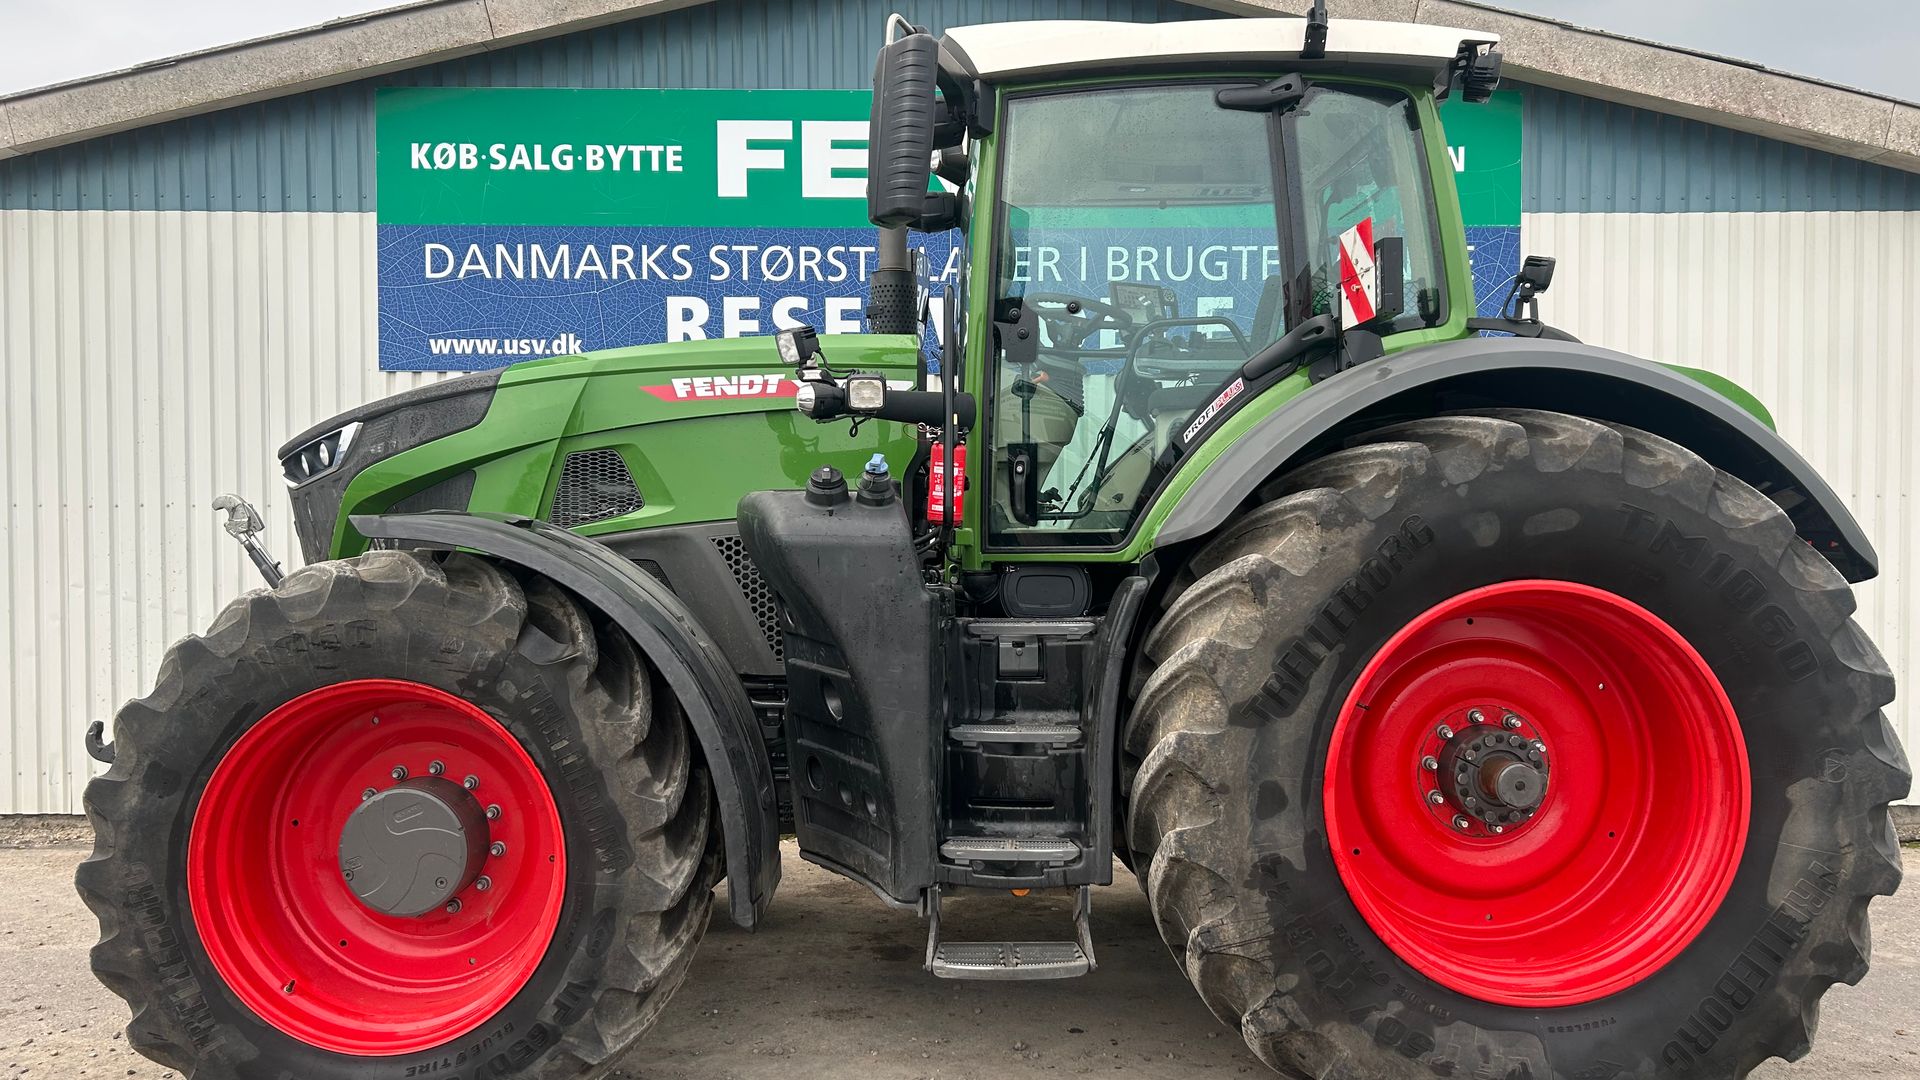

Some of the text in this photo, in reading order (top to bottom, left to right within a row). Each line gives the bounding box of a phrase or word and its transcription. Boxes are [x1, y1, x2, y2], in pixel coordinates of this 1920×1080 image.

[716, 119, 870, 198] FE
[424, 242, 694, 281] DANMARKS
[709, 244, 877, 283] STØRST
[666, 296, 862, 343] RESE
[429, 333, 583, 355] www.usv.dk
[671, 373, 786, 398] FENDT
[1239, 513, 1435, 723] TRELLEBORG
[1615, 502, 1821, 683] TM1060
[520, 674, 629, 876] TRELLEBORG
[121, 861, 226, 1060] TRELLEBORG
[1661, 860, 1849, 1074] TRELLEBORG
